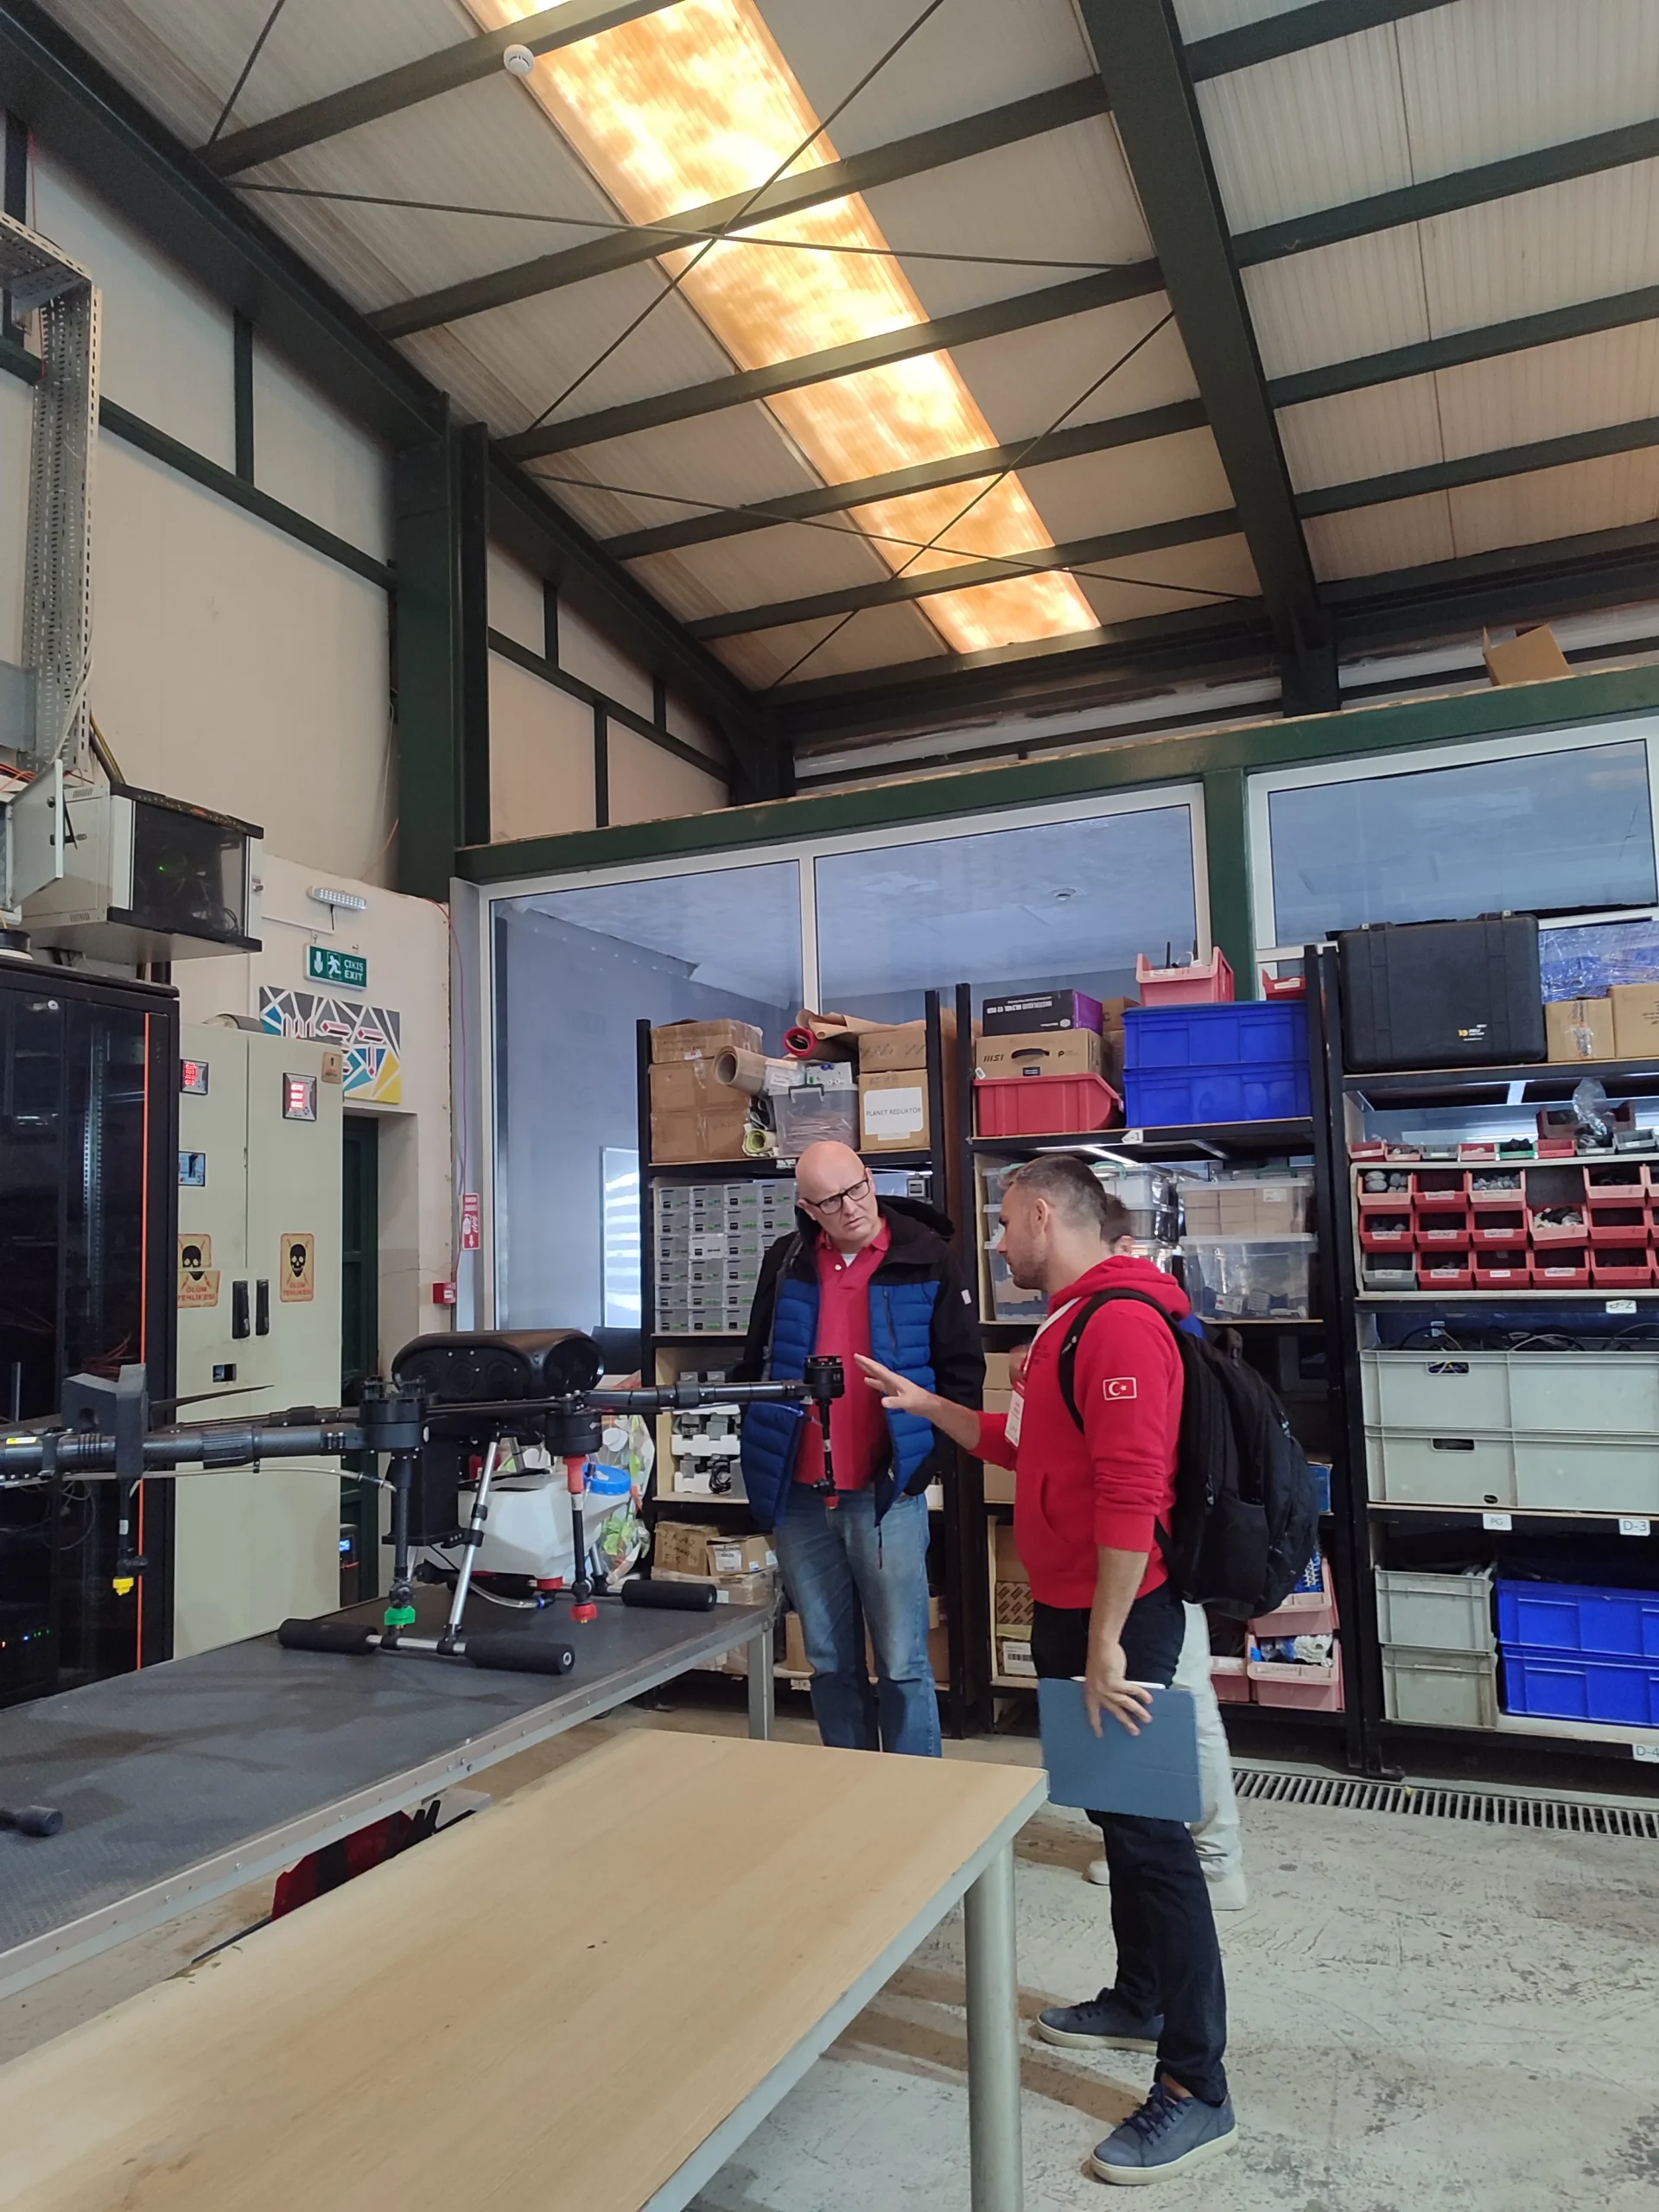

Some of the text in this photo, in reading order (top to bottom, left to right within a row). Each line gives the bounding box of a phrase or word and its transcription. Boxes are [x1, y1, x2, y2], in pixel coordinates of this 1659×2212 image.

[344, 959, 364, 973] ÇIKIŞ
[344, 969, 363, 982] EXIT
[889, 1107, 921, 1116] REDÜKTÖR
[1491, 1517, 1503, 1526] PG
[1623, 1520, 1647, 1532] D-3
[1636, 1745, 1659, 1758] D-4
